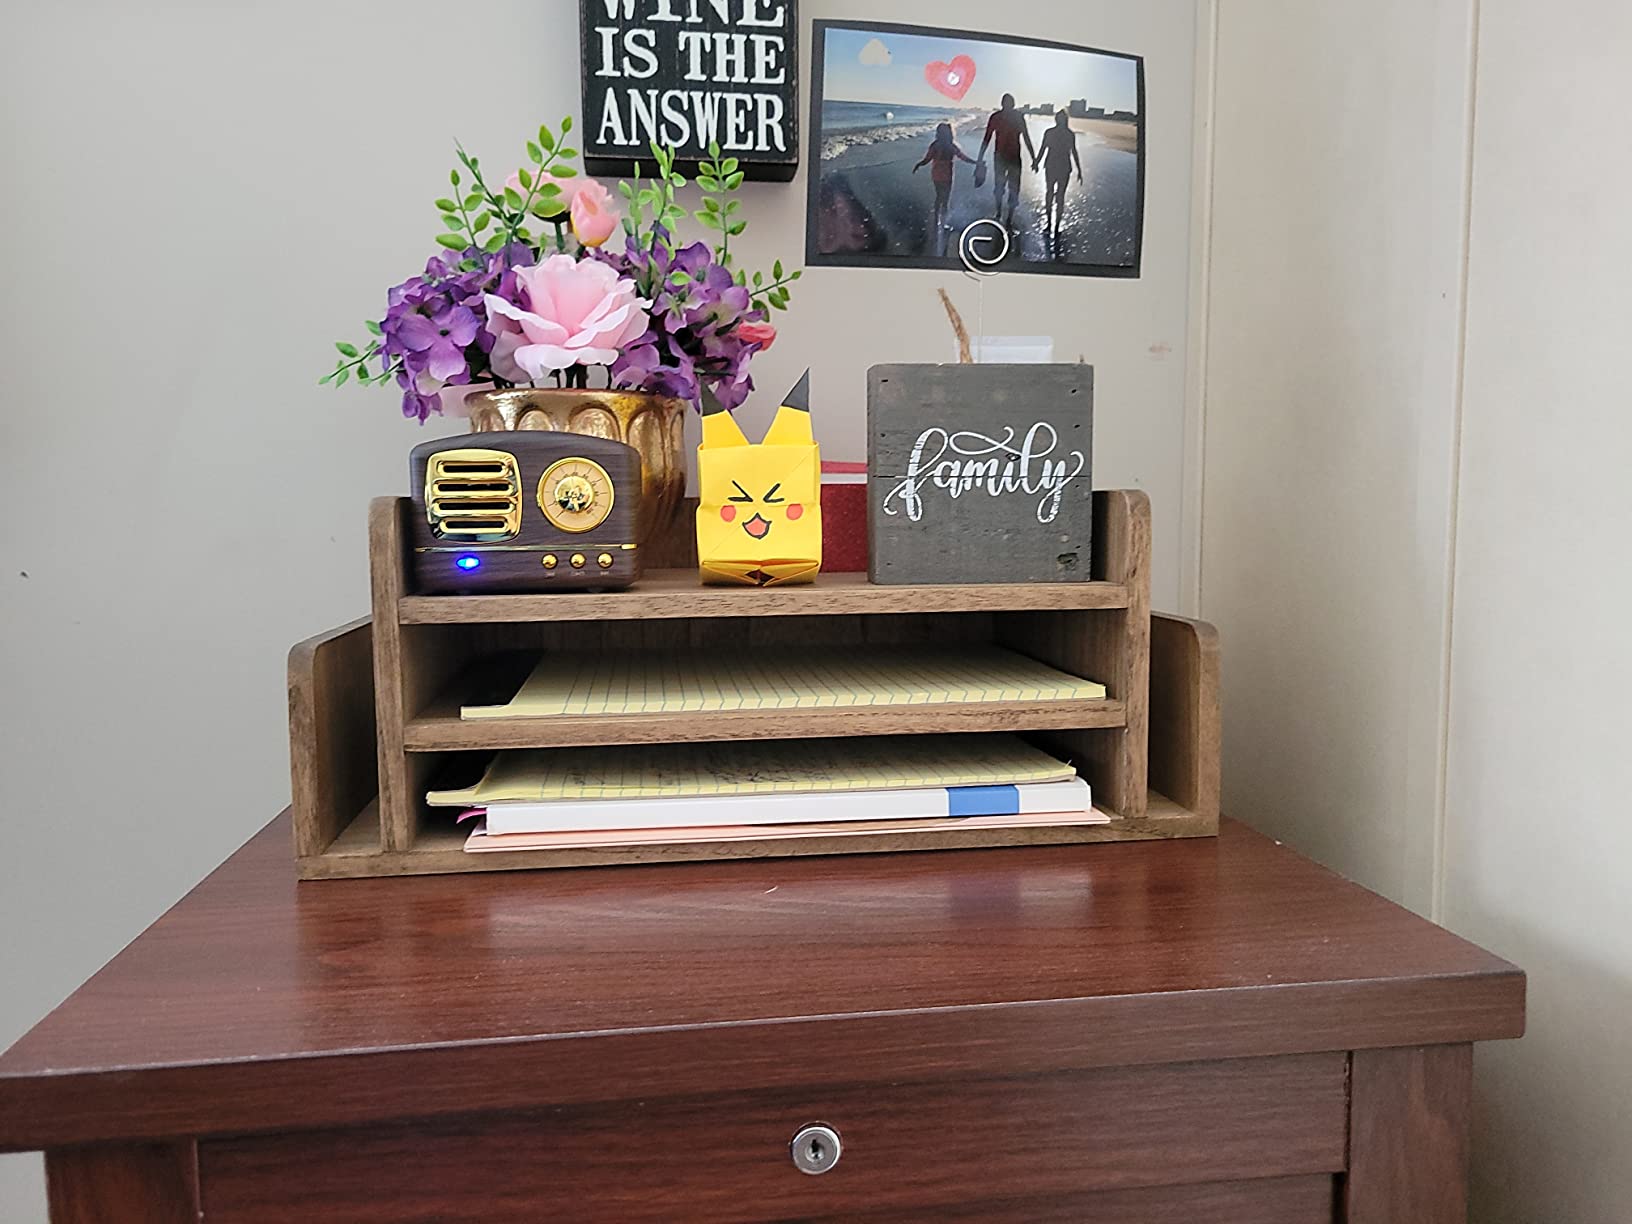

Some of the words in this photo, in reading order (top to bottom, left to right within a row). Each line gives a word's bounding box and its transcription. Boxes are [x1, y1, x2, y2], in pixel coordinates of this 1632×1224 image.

[594, 27, 659, 79] IS
[678, 31, 785, 84] THE
[595, 87, 786, 152] ANSWER
[883, 421, 1085, 523] family
